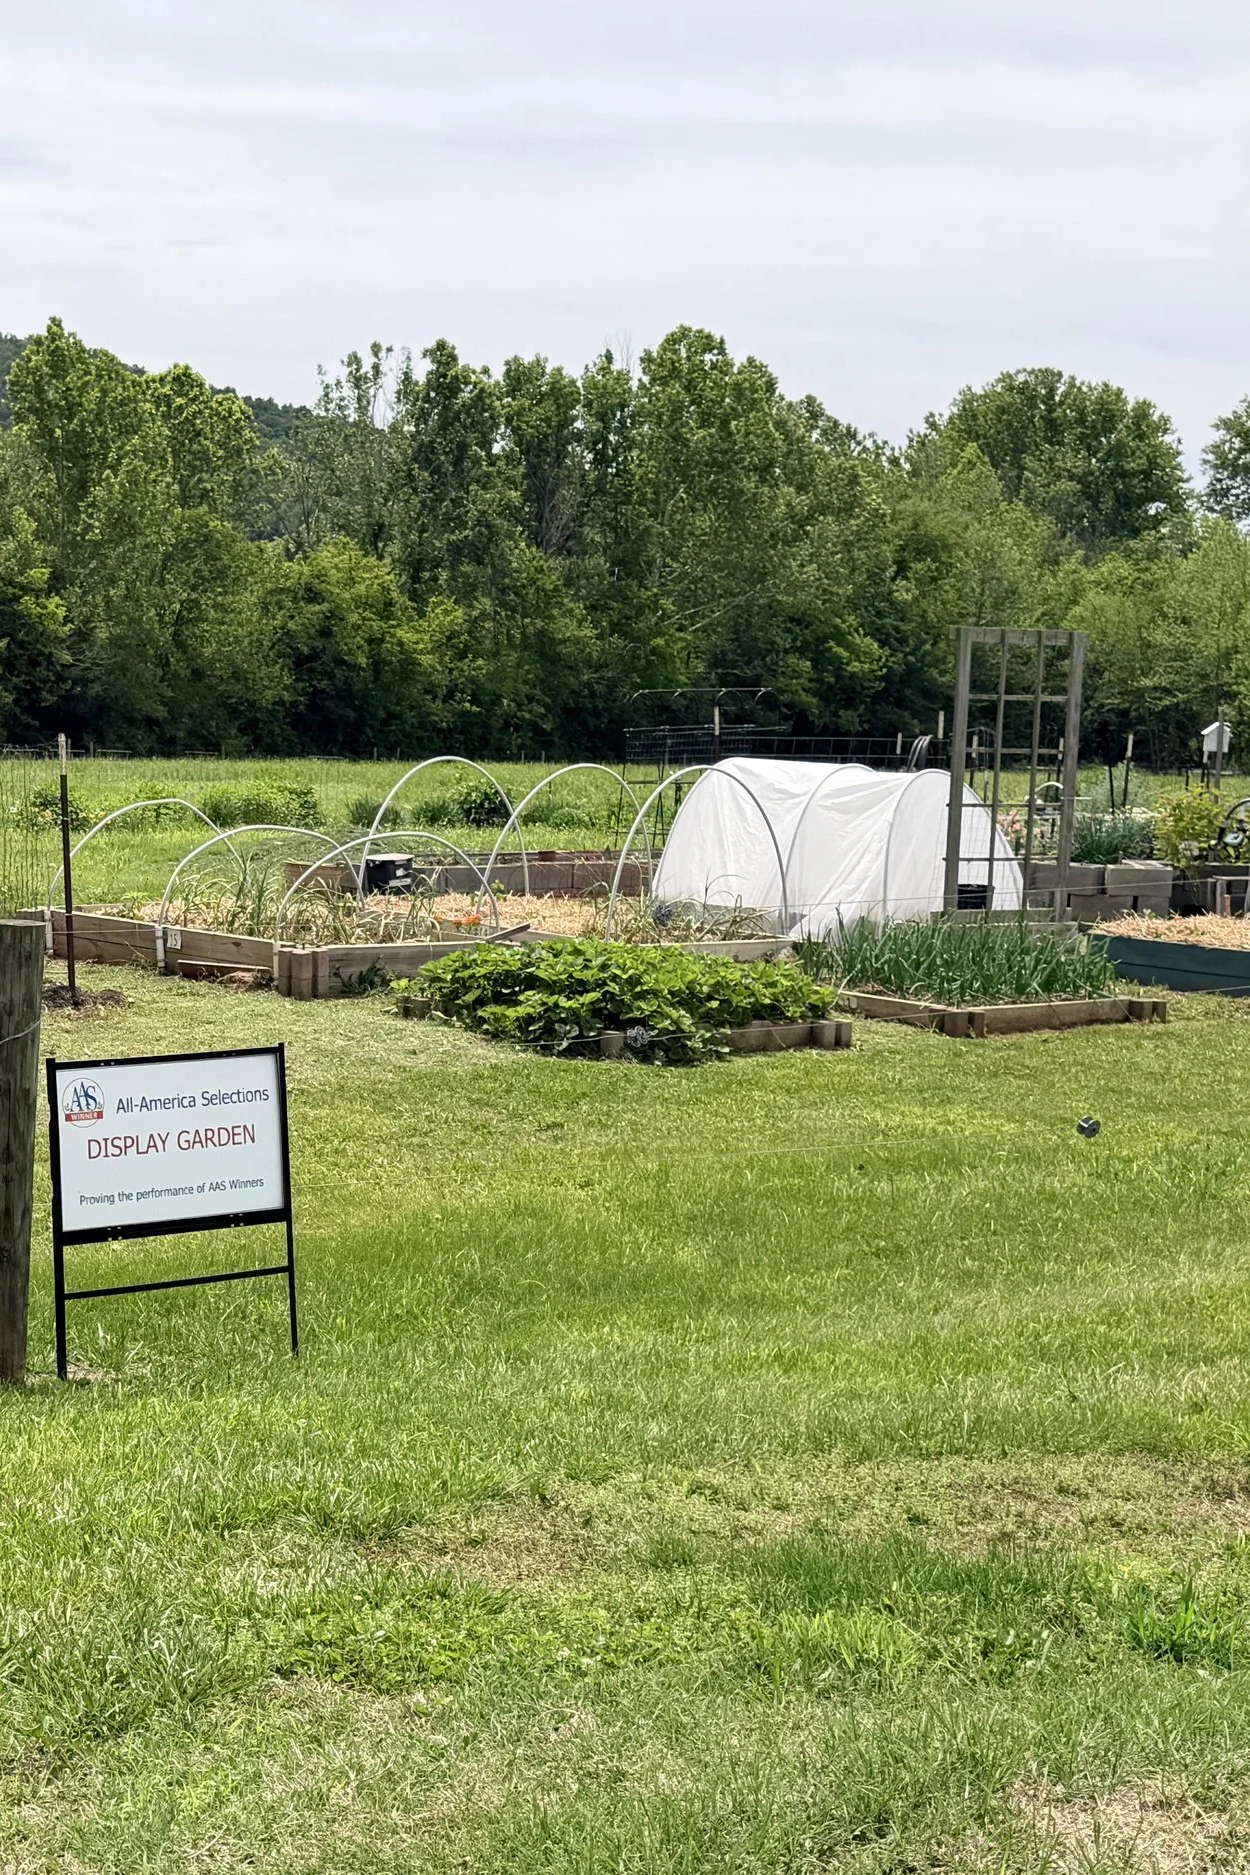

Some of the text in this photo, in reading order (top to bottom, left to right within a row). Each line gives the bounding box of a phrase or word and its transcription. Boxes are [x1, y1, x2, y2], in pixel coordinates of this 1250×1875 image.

[70, 1081, 98, 1112] AAS
[116, 1087, 270, 1114] All-America Selections
[70, 1111, 98, 1121] WINNER
[87, 1124, 256, 1159] DISPLAY GARDEN
[79, 1178, 265, 1205] Proving the performance of AAS Winners
